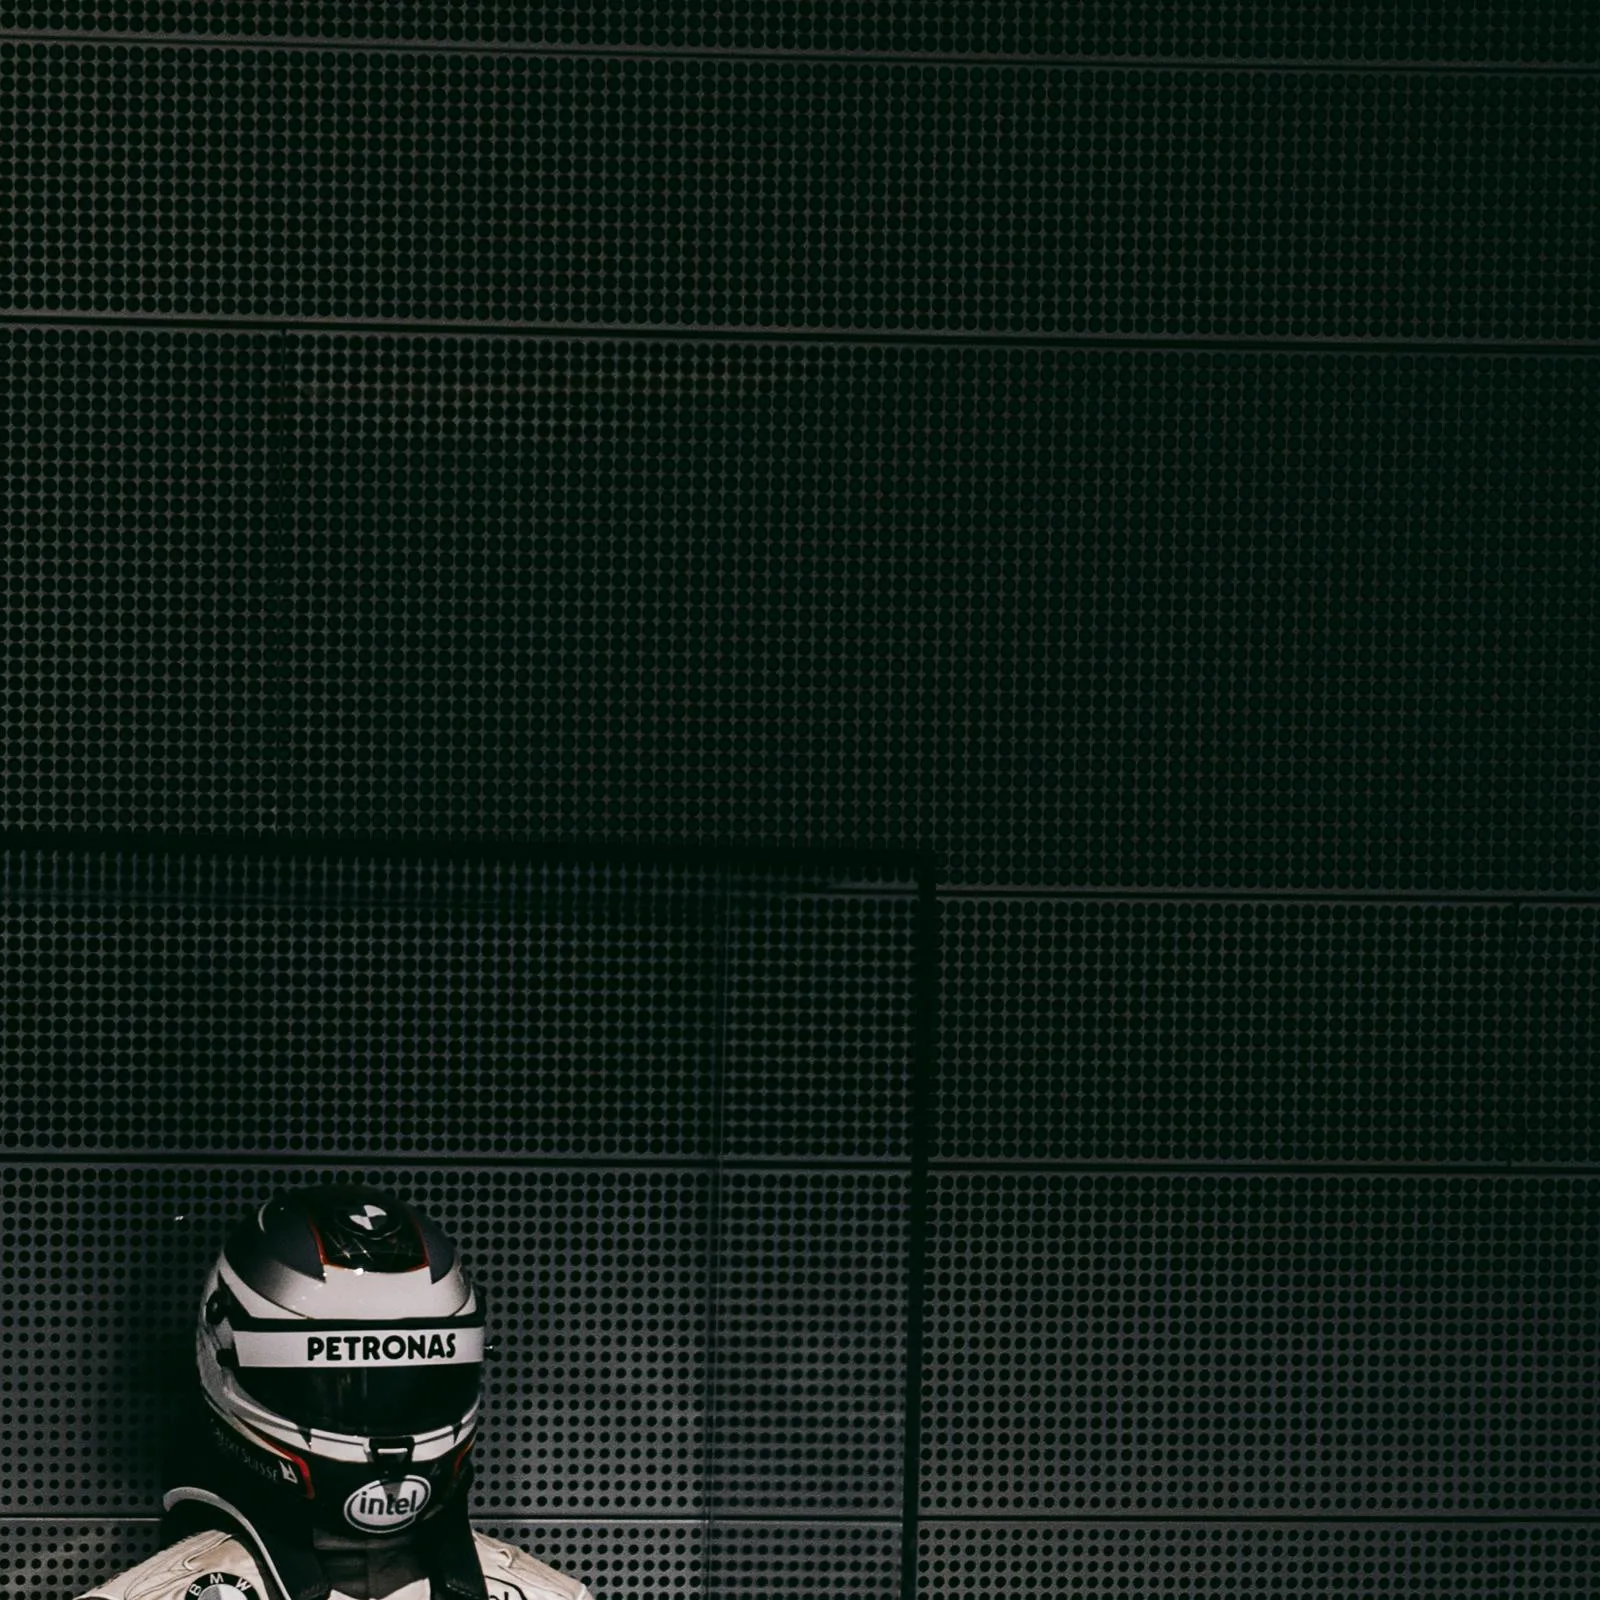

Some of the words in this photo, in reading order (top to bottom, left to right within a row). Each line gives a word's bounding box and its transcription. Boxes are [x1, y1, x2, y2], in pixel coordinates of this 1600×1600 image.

[305, 1333, 457, 1362] PETRONAS
[359, 1490, 418, 1516] intel
[188, 1572, 253, 1597] BMW
